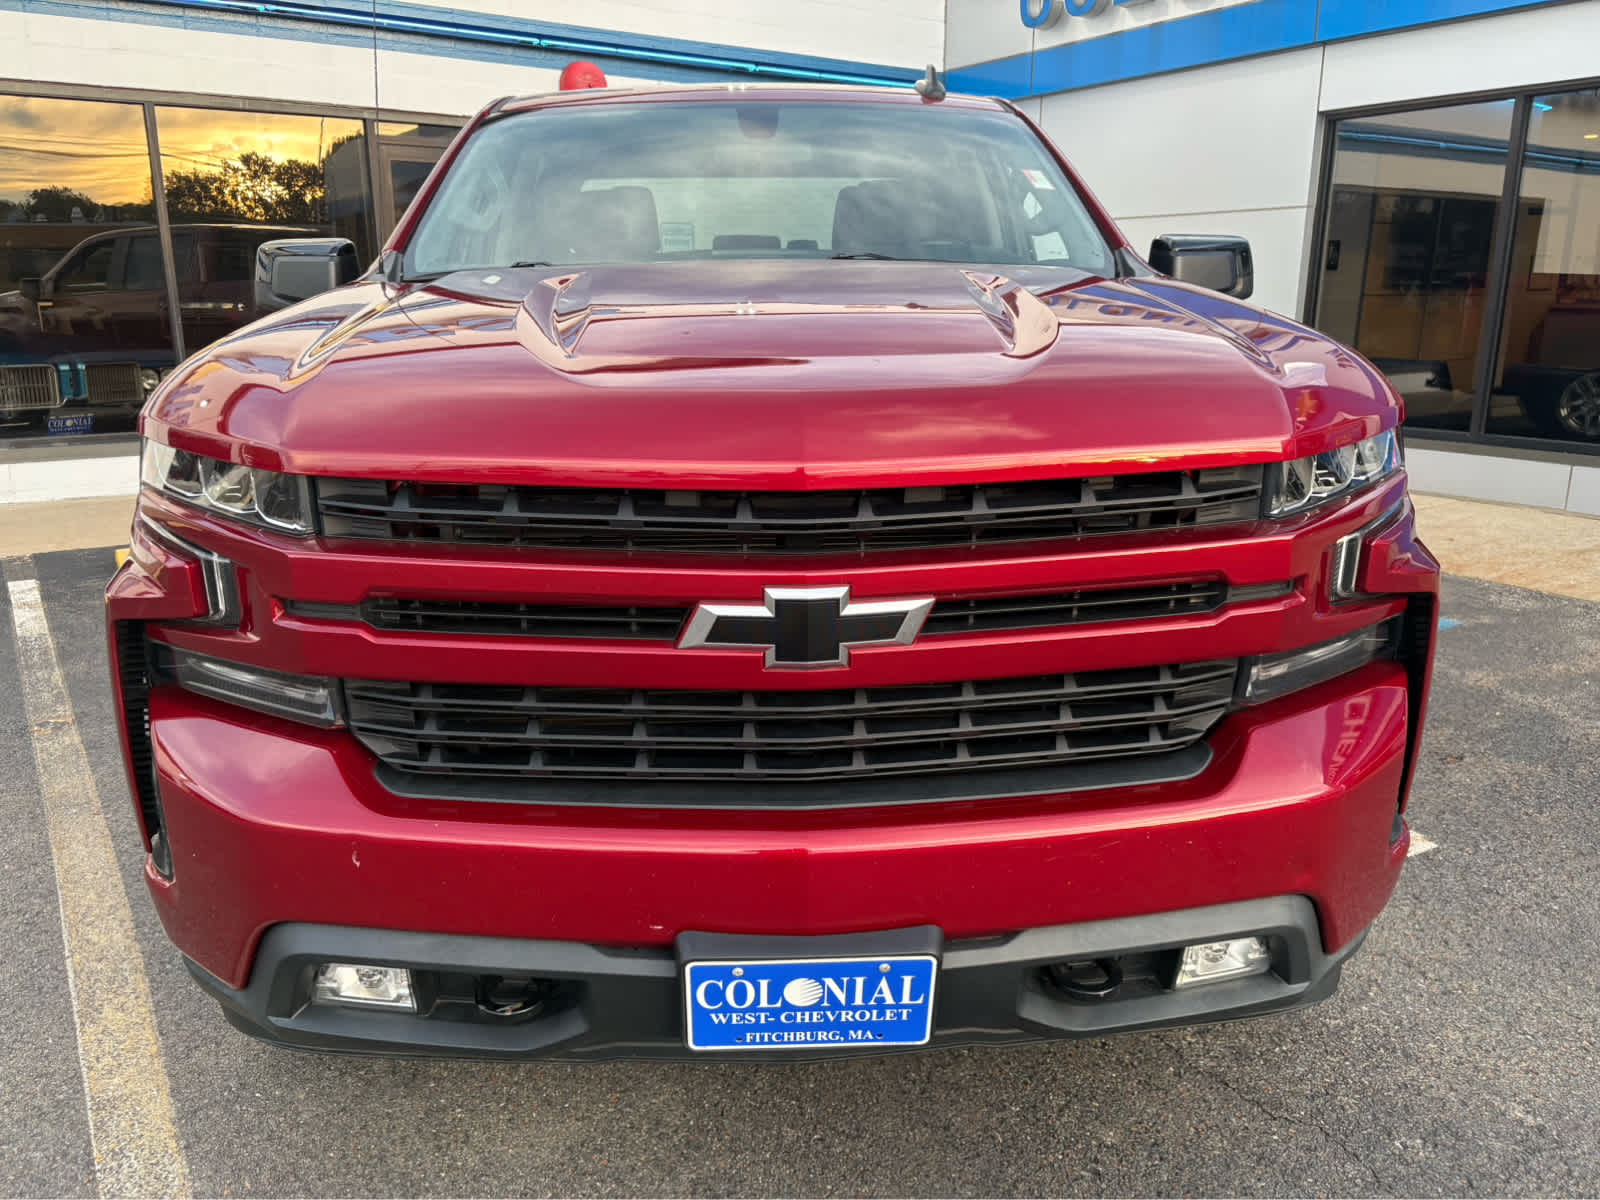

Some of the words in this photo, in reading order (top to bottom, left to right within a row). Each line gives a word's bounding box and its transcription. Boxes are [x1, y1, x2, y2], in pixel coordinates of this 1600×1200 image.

[696, 976, 924, 1009] COLONIAL
[710, 1011, 776, 1025] WEST-
[780, 1008, 912, 1024] CHEVROLET
[745, 1030, 845, 1043] FITCHBURG,
[848, 1029, 873, 1041] MA
